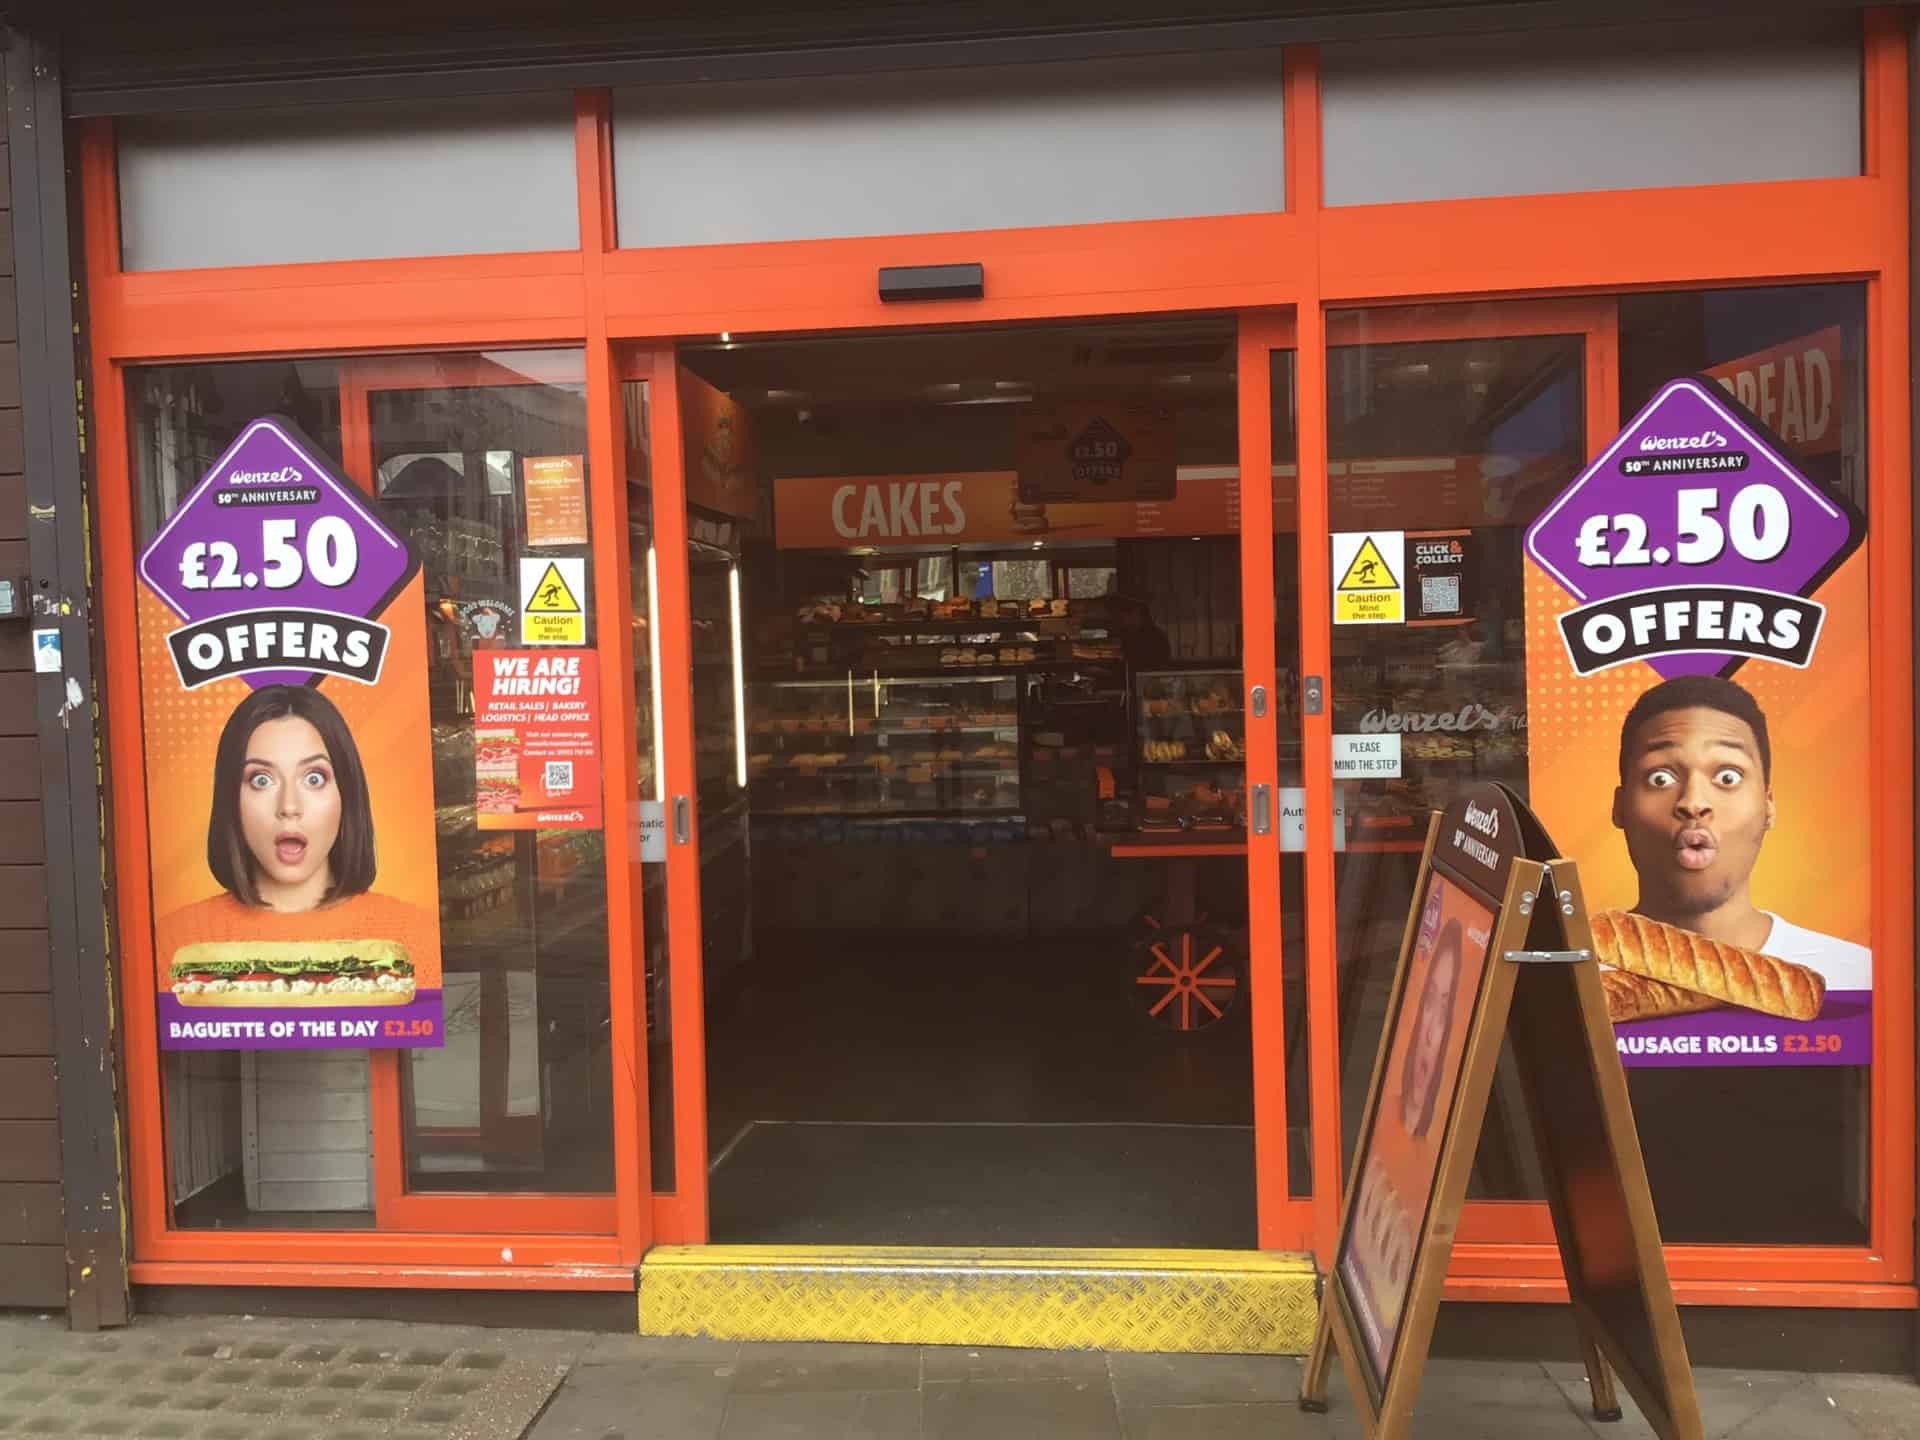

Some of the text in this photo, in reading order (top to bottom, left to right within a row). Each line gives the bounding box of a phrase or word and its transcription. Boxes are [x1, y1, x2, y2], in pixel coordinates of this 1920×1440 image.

[1716, 347, 1832, 443] READ
[1653, 455, 1743, 471] ANNIVERSARY
[241, 490, 317, 503] ANNIVERSARY
[832, 481, 966, 539] CAKES
[1575, 483, 1790, 567] £2.50
[179, 515, 358, 589] £2.50
[1415, 540, 1463, 555] CLICK &
[1415, 554, 1464, 565] COLLECT
[1347, 593, 1391, 604] Caution
[533, 615, 574, 626] Caution
[1582, 600, 1802, 655] OFFERS
[187, 622, 371, 671] OFFERS
[493, 656, 580, 677] WE ARE
[492, 677, 580, 697] HIRING!
[488, 702, 517, 711] RETAIL
[552, 701, 586, 710] BAKERY
[481, 713, 590, 722] LOGISTICS HEAD OFFICE
[1349, 741, 1381, 753] PLEASE
[1334, 759, 1398, 770] MIND THE STEP
[170, 1019, 433, 1039] BAGUETTE OF THE DAY £2.50
[1707, 1035, 1778, 1053] ROLLS
[1783, 1034, 1841, 1053] £2.50
